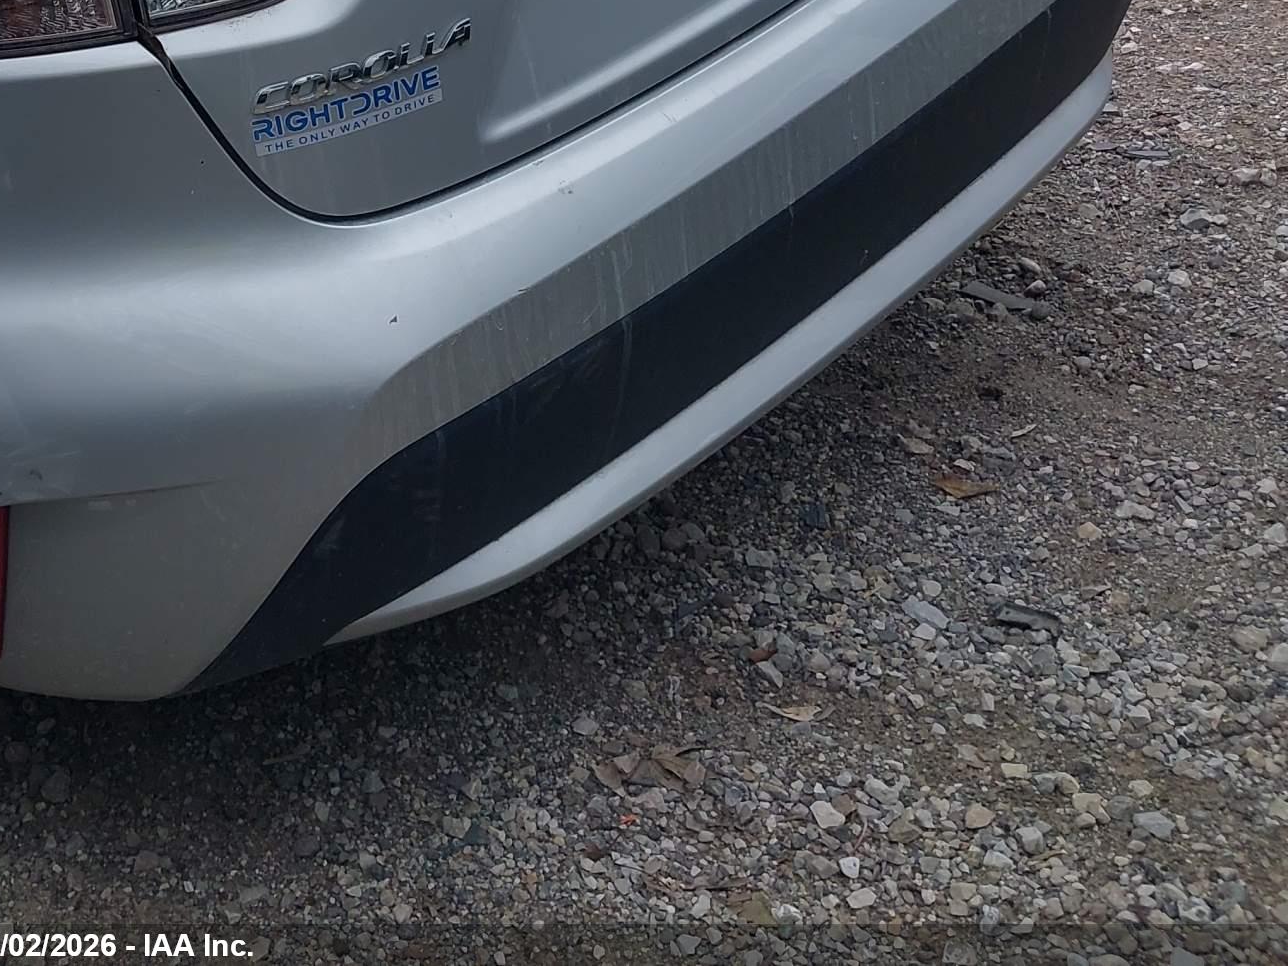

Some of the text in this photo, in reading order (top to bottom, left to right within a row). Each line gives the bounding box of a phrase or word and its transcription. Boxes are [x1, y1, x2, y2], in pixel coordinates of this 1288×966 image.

[253, 18, 472, 115] COROLLA
[264, 95, 434, 153] THE ONLY WAY TO DRIVE
